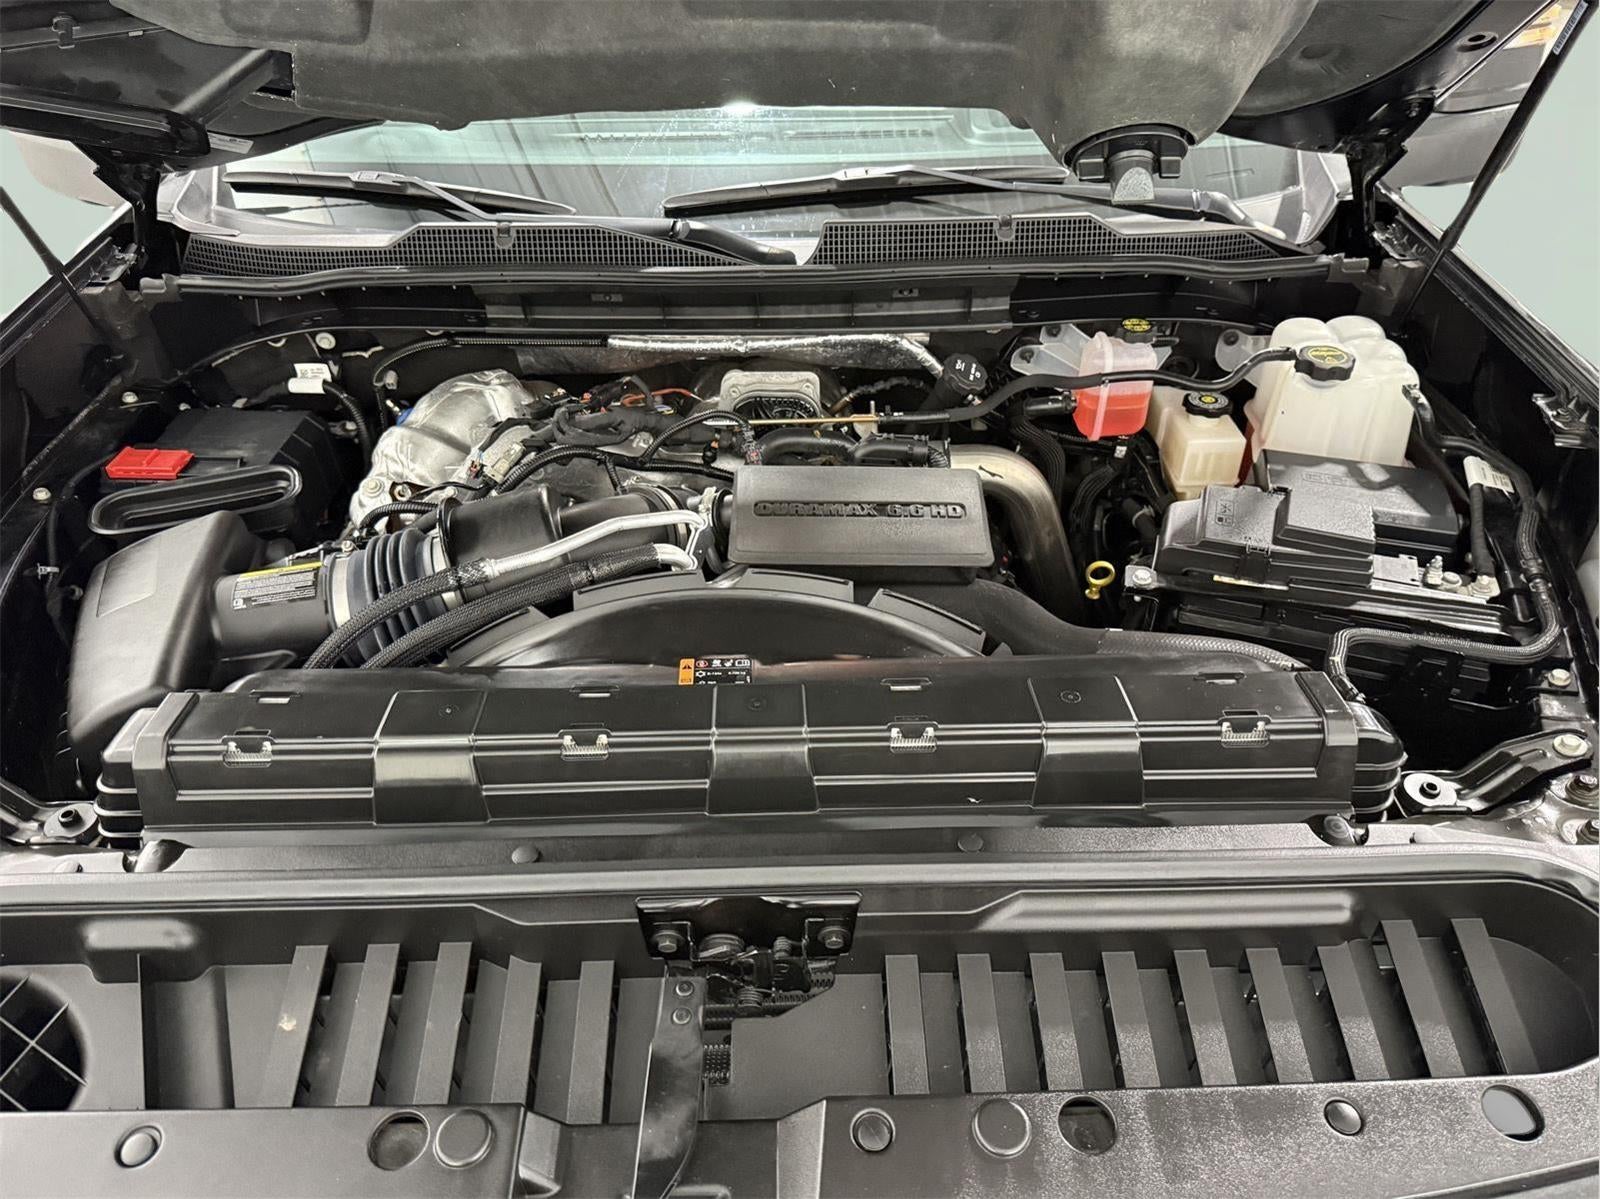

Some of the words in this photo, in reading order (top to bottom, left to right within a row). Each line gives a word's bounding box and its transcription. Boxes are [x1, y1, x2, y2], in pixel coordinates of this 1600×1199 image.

[755, 502, 878, 517] DURAMAX
[887, 503, 925, 518] 6.6
[930, 504, 963, 518] HD
